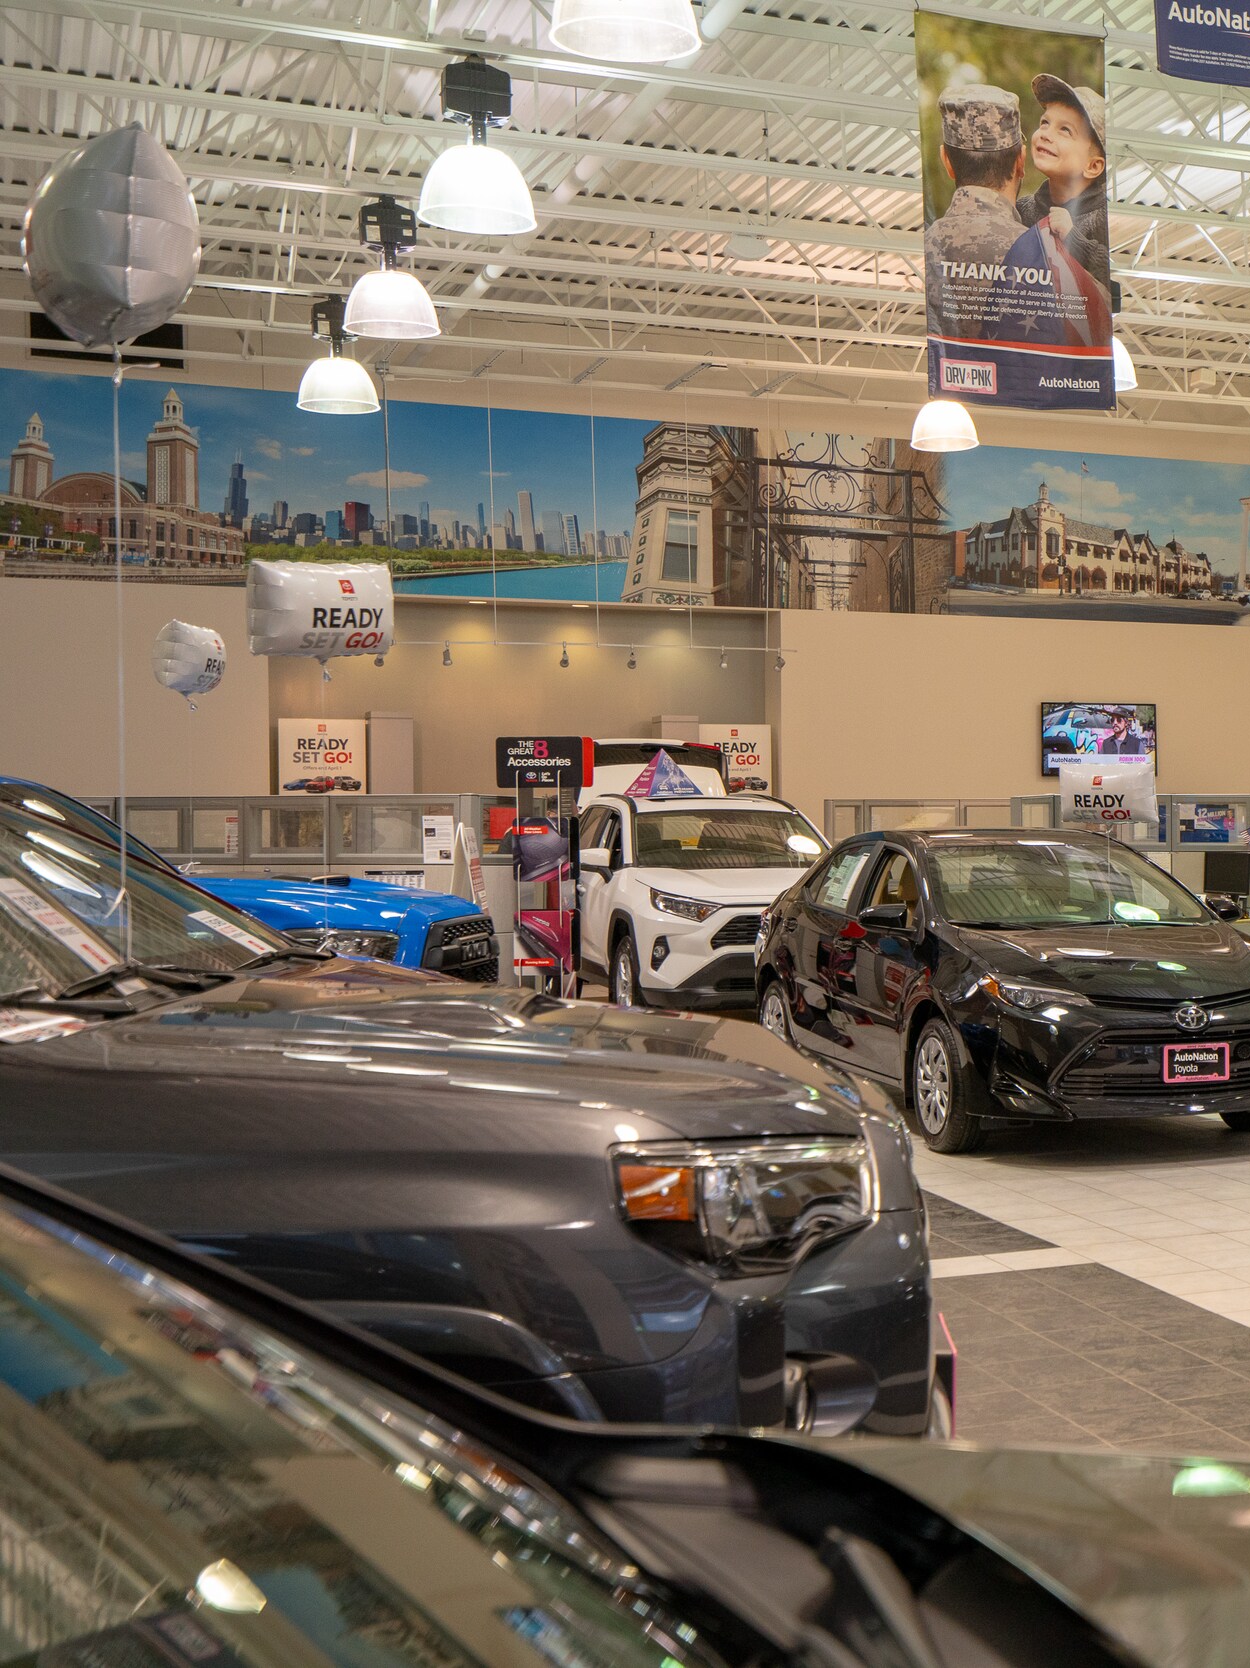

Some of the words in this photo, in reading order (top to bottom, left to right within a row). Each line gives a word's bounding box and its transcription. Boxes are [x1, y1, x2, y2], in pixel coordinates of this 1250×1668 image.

[941, 261, 1007, 281] THANK
[1014, 267, 1053, 286] YOU.
[995, 297, 1018, 305] continue
[1027, 291, 1054, 299] Associates
[1060, 294, 1088, 302] Customers
[943, 301, 960, 310] Forces.
[962, 303, 979, 311] Thank
[1000, 307, 1026, 315] defending
[1038, 310, 1054, 318] liberty
[943, 311, 972, 320] throughout
[945, 366, 966, 384] DRV
[972, 368, 992, 387] PNK
[1039, 377, 1100, 389] AutoNation
[313, 608, 383, 629] READY
[300, 632, 343, 649] SET
[345, 632, 384, 649] GO!
[298, 739, 349, 750] READY
[534, 740, 548, 758] 8
[714, 742, 757, 753] READY
[293, 752, 320, 763] SET
[324, 752, 353, 763] GO!
[507, 756, 571, 767] Accessories
[736, 755, 760, 765] GO!
[1074, 795, 1125, 808] READY
[1073, 810, 1097, 820] SET
[1101, 810, 1132, 820] GO!
[1198, 807, 1207, 817] 12
[1207, 810, 1226, 818] MILLION
[1174, 1053, 1219, 1061] AutoNation
[1174, 1064, 1198, 1074] Toyota
